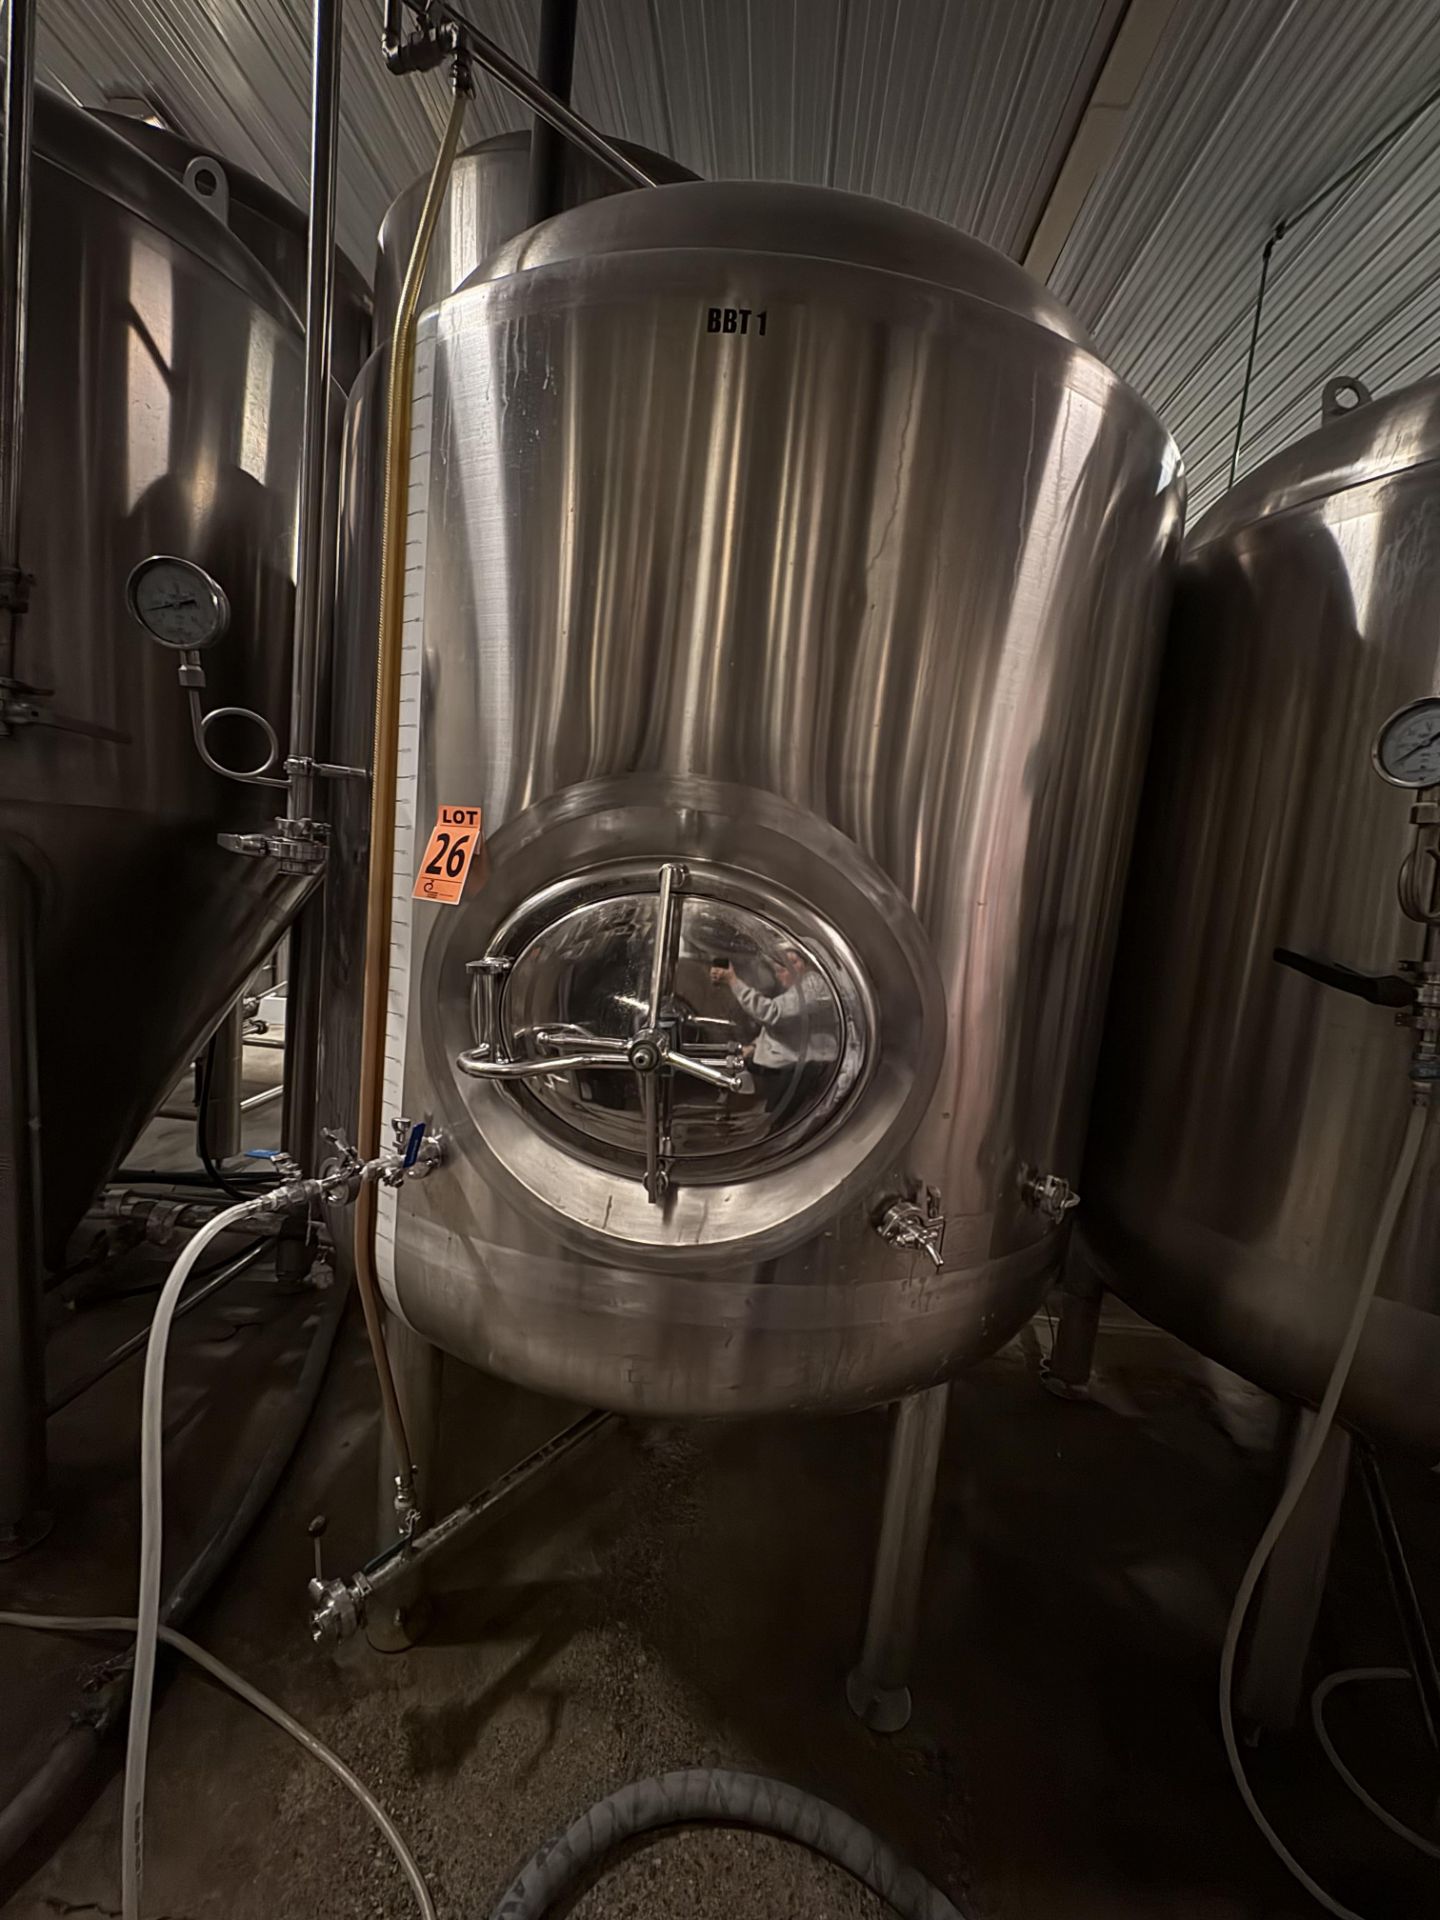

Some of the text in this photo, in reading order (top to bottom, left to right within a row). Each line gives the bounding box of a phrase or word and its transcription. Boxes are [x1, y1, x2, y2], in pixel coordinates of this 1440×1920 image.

[707, 307, 767, 336] BBT 1
[442, 809, 478, 825] LOT
[425, 833, 470, 877] 26
